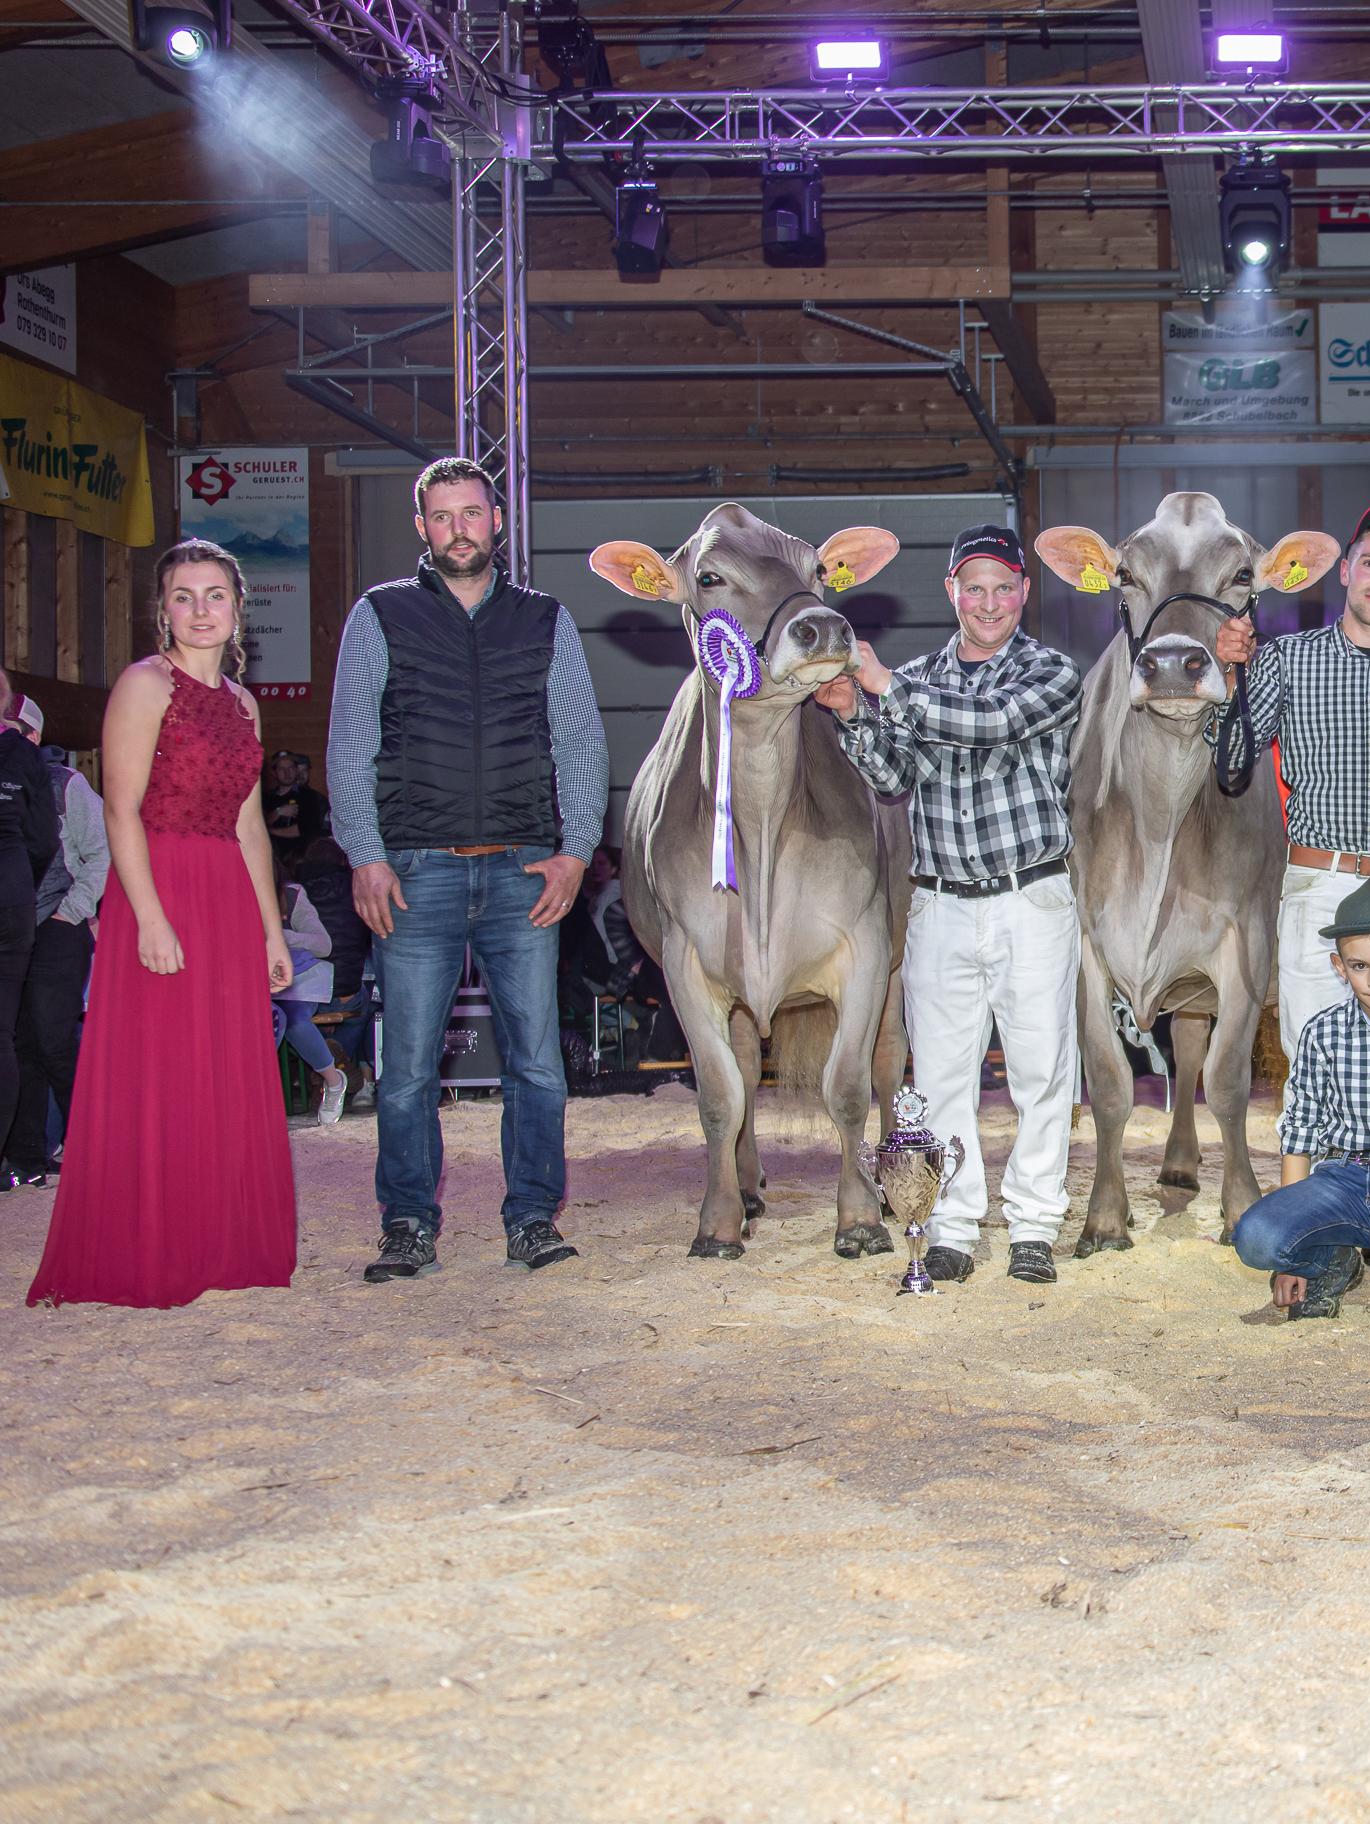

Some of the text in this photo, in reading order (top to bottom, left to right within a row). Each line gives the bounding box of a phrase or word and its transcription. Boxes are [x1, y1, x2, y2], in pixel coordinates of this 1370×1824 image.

[32, 276, 56, 305] Abegg
[17, 291, 67, 331] Rothenthurm
[17, 315, 68, 352] 079 329 10 07
[1169, 324, 1199, 339] Bauen
[1347, 386, 1360, 397] Die
[1171, 395, 1310, 408] March und Umgebung
[0, 417, 127, 505] Flurin Futter
[233, 461, 298, 474] SCHULER
[252, 475, 305, 484] GERUEST.CH
[282, 583, 297, 593] für:
